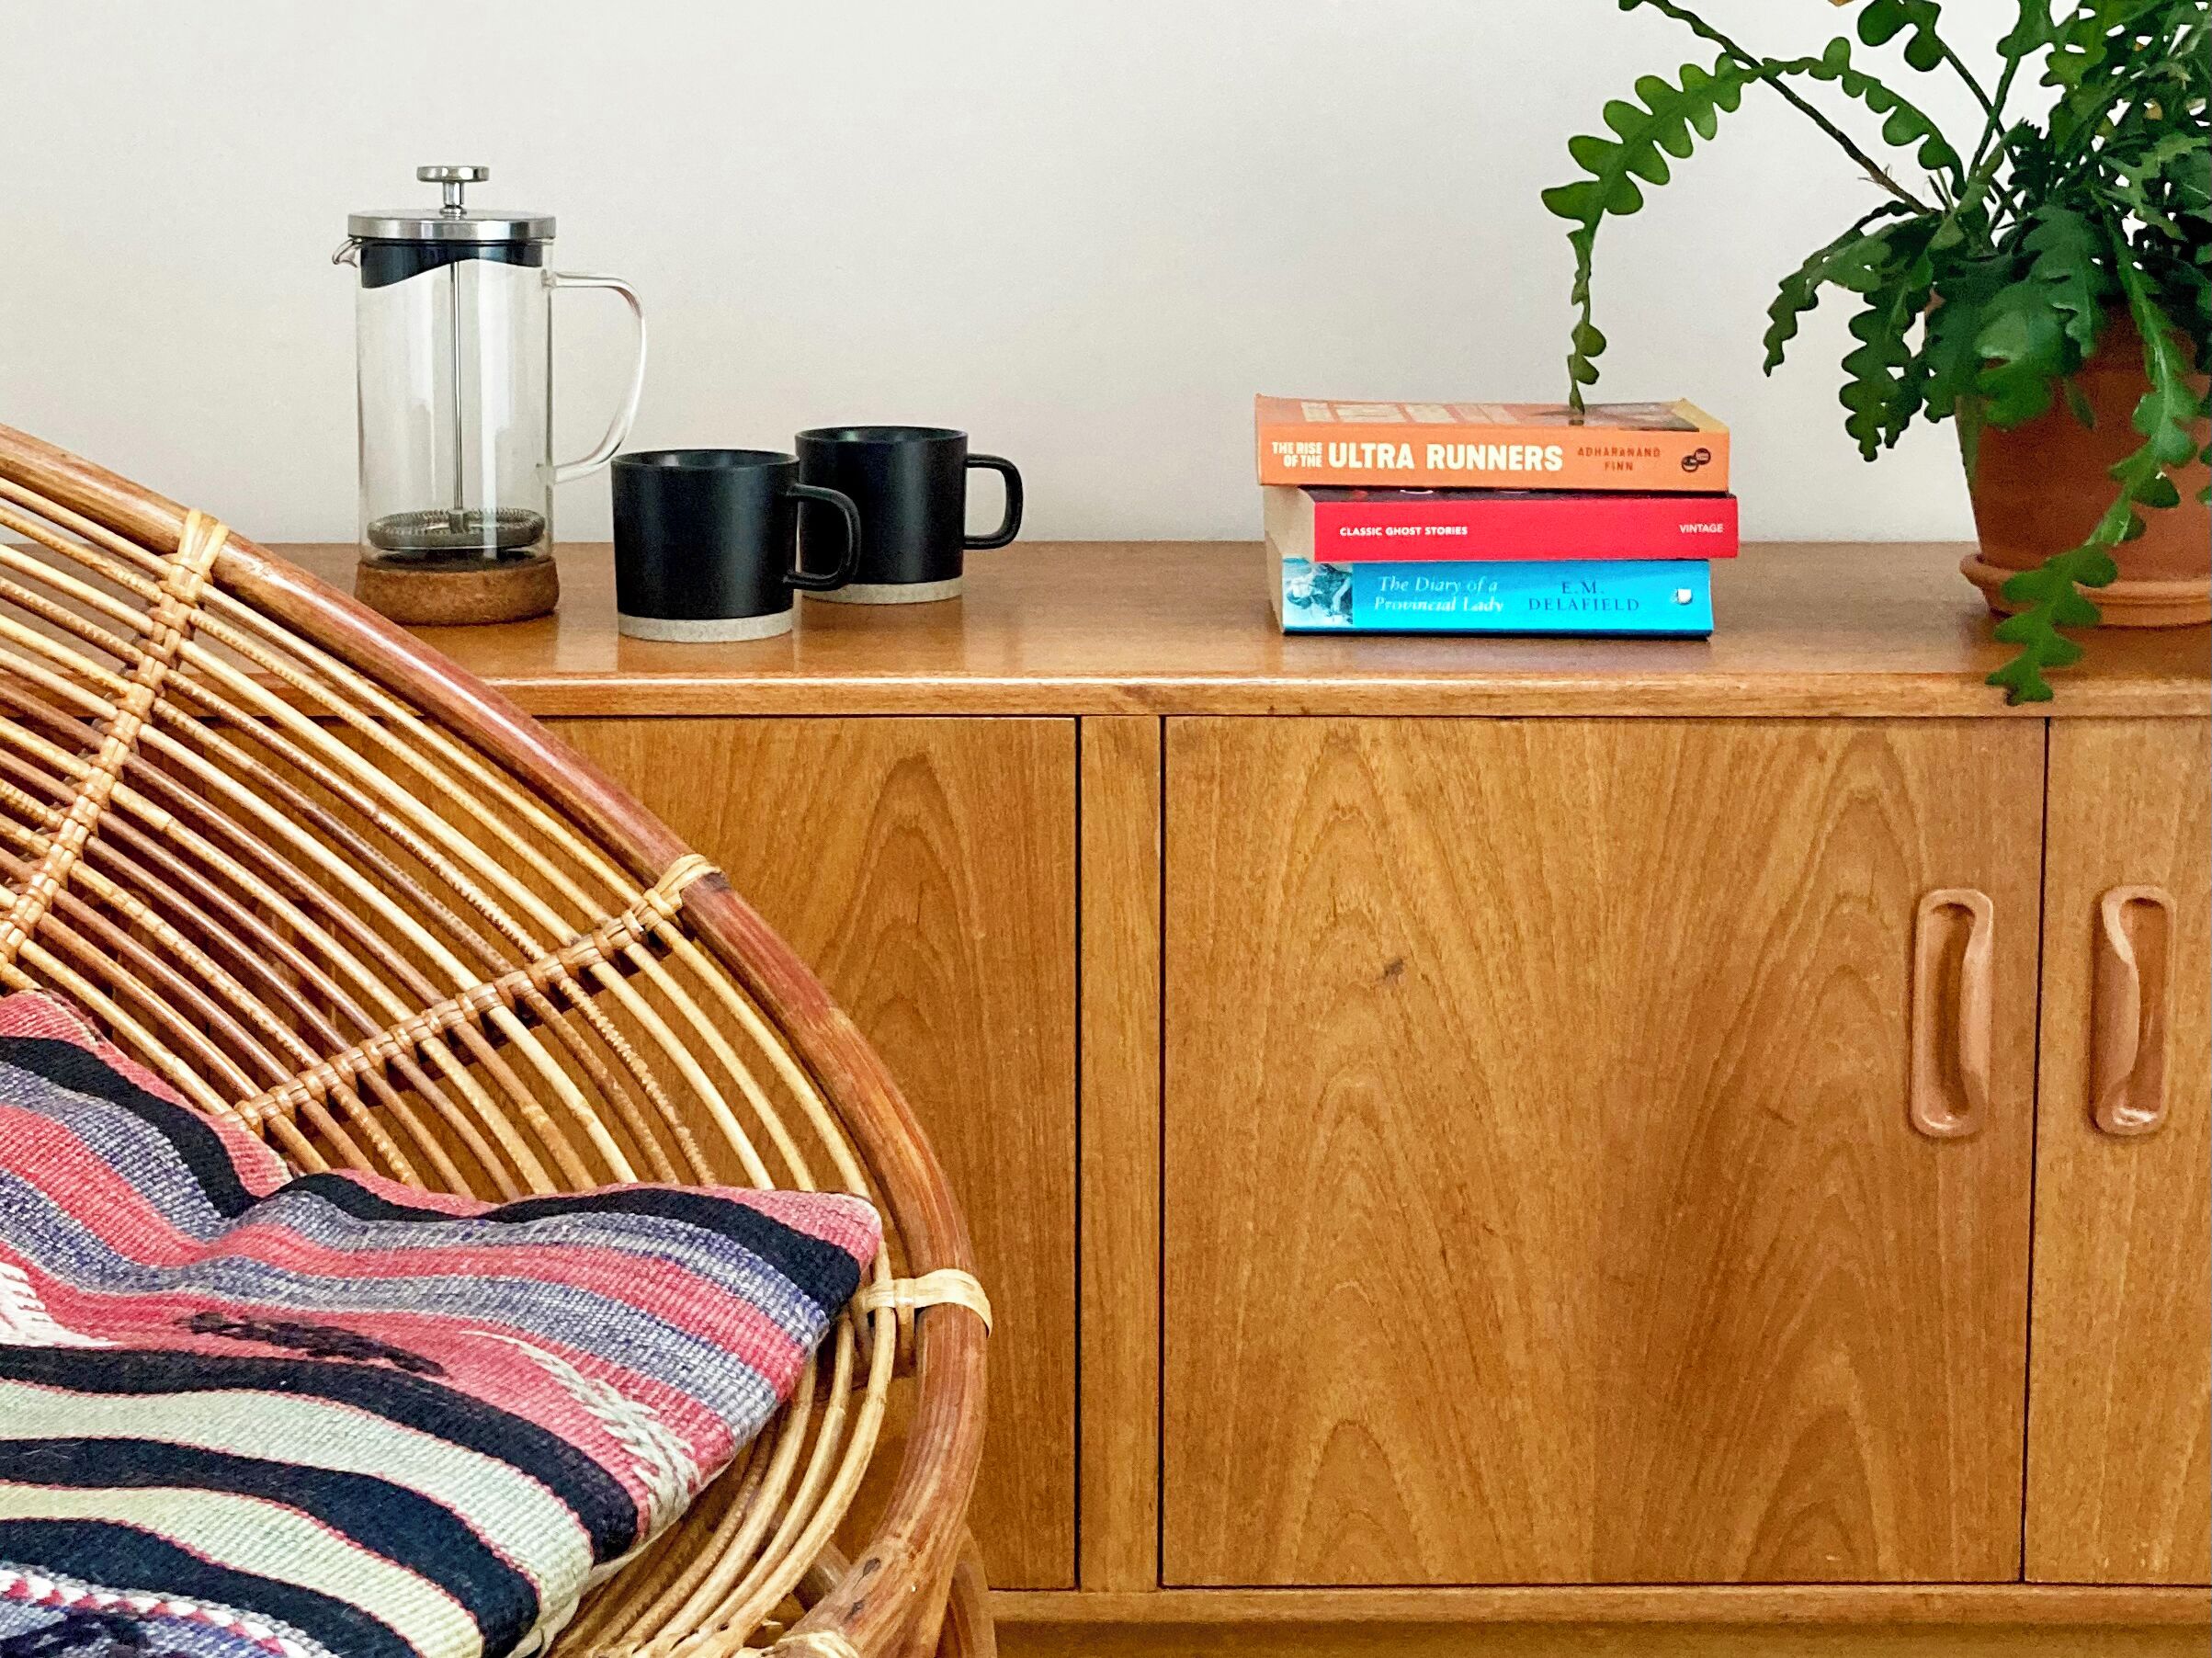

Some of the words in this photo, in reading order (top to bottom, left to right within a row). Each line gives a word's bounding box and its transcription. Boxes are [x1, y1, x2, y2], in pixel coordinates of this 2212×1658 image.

[1272, 441, 1294, 454] THE
[1296, 441, 1323, 454] RISE
[1577, 446, 1662, 458] ADHARANAND
[1283, 454, 1299, 468] OF
[1301, 454, 1322, 468] THE
[1328, 442, 1415, 470] ULTRA
[1426, 443, 1563, 471] RUNNERS
[1605, 460, 1634, 471] FINN
[1339, 527, 1382, 537] CLASSIC
[1385, 527, 1422, 537] GHOST
[1424, 526, 1468, 536] STORIES
[1679, 523, 1724, 534] VINTAGE
[1379, 574, 1410, 592] The
[1415, 575, 1461, 596] Diary
[1467, 574, 1487, 595] of
[1488, 581, 1498, 593] a
[1561, 580, 1605, 595] E.M.
[1374, 596, 1457, 612] Provincial
[1463, 596, 1504, 613] Lady
[1528, 597, 1639, 612] DELAFIELD
